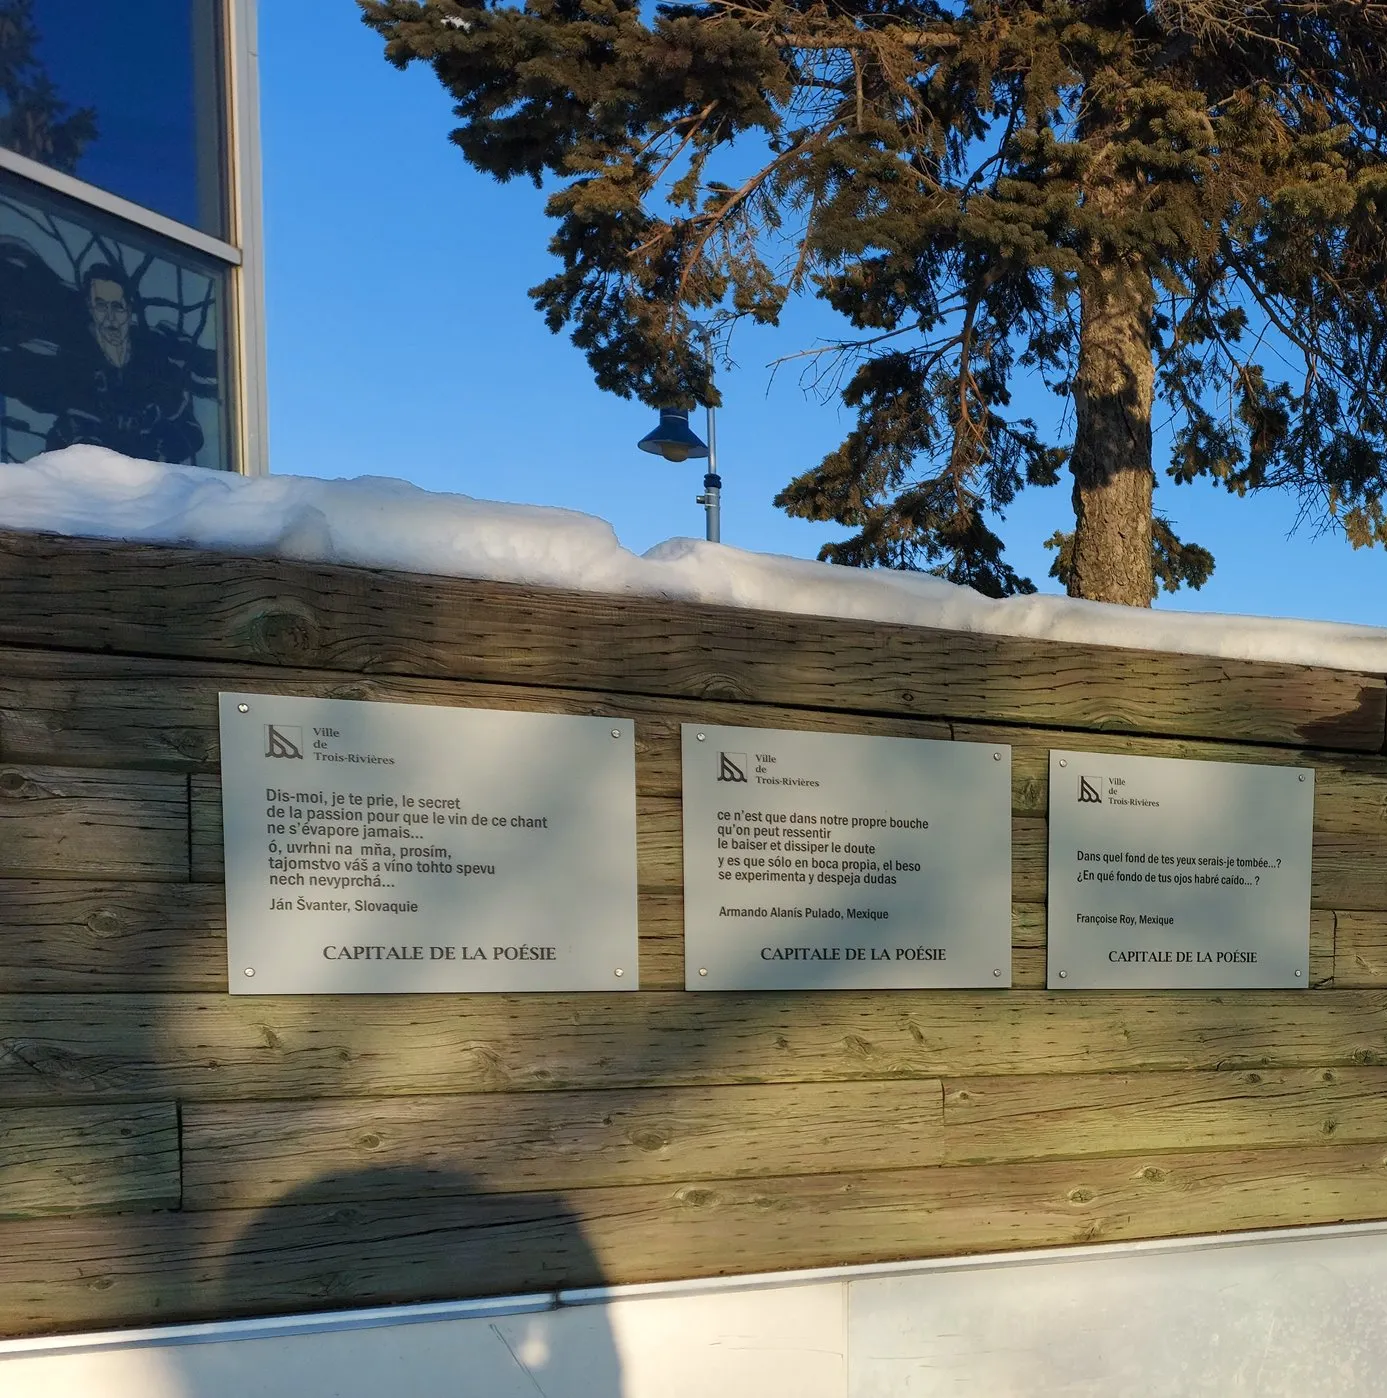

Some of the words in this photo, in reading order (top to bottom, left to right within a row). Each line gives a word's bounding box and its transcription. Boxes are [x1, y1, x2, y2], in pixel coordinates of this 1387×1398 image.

[312, 727, 339, 737] Ville
[313, 739, 327, 749] de
[313, 751, 395, 765] Trois-Rivières
[755, 775, 819, 787] Trois-Rivières
[266, 788, 327, 805] Dis-moi,
[330, 791, 345, 807] je
[348, 793, 362, 805] te
[366, 793, 397, 809] prie,
[402, 794, 414, 807] le
[418, 796, 461, 809] secret
[266, 805, 285, 818] de
[289, 805, 302, 818] la
[306, 806, 362, 823] passion
[367, 811, 400, 825] pour
[402, 813, 428, 826] que
[432, 811, 445, 824] le
[447, 812, 467, 825] vin
[471, 813, 488, 826] de
[491, 816, 506, 826] ce
[510, 815, 547, 828] chant
[717, 811, 730, 820] ce
[765, 813, 786, 825] que
[789, 812, 816, 824] dans
[820, 814, 848, 825] notre
[851, 817, 886, 829] propre
[889, 816, 928, 829] bouche
[267, 823, 285, 834] ne
[361, 824, 423, 841] jamais...
[753, 825, 779, 839] peut
[782, 826, 831, 839] ressentir
[268, 839, 282, 855] ó,
[287, 840, 330, 854] uvrhni
[335, 845, 352, 854] na
[360, 842, 395, 858] mňa,
[400, 843, 451, 860] prosím,
[717, 837, 728, 849] le
[731, 838, 767, 850] baiser
[769, 840, 781, 851] et
[784, 840, 829, 854] dissiper
[831, 841, 841, 853] le
[843, 842, 875, 854] doute
[268, 856, 340, 873] tajomstvo
[344, 857, 368, 871] váš
[372, 861, 380, 871] a
[383, 858, 412, 872] víno
[416, 860, 452, 873] tohto
[456, 864, 495, 876] spevu
[717, 856, 724, 868] y
[727, 856, 740, 866] es
[743, 857, 764, 869] que
[767, 855, 791, 867] sólo
[794, 859, 808, 868] en
[811, 857, 838, 869] boca
[841, 858, 879, 872] propia,
[883, 859, 892, 870] el
[895, 860, 920, 871] beso
[1077, 850, 1100, 861] Dans
[1102, 851, 1122, 864] quel
[1125, 852, 1145, 863] fond
[1147, 853, 1159, 863] de
[1161, 854, 1174, 864] tes
[1176, 856, 1196, 867] yeux
[1197, 855, 1234, 868] serais-je
[1236, 856, 1281, 868] tombée...?
[269, 872, 304, 885] nech
[309, 872, 394, 890] nevyprchá...
[718, 870, 731, 880] se
[734, 869, 805, 884] experimenta
[808, 873, 814, 884] y
[817, 871, 860, 885] despeja
[863, 872, 896, 884] dudas
[1076, 869, 1094, 882] ¿En
[1096, 870, 1114, 883] qué
[1116, 870, 1142, 882] fondo
[1144, 872, 1156, 882] de
[1157, 873, 1171, 882] tus
[1173, 873, 1192, 885] ojos
[1194, 873, 1219, 884] habré
[1254, 875, 1259, 885] ?
[269, 897, 292, 910] Ján
[296, 895, 350, 912] Švanter,
[354, 899, 418, 914] Slovaquie
[718, 906, 767, 917] Armando
[770, 906, 802, 917] Alanís
[805, 907, 843, 918] Pulado,
[846, 908, 888, 920] Mexique
[1076, 913, 1117, 925] Françoise
[1119, 914, 1136, 926] Roy,
[1139, 914, 1173, 926] Mexique
[322, 945, 423, 960] CAPITALE
[429, 946, 455, 960] DE
[462, 947, 487, 960] LA
[493, 943, 556, 960] POÉSIE
[760, 947, 840, 960] CAPITALE
[845, 948, 865, 960] DE
[871, 948, 890, 960] LA
[895, 945, 946, 960] POÉSIE
[1108, 950, 1172, 962] CAPITALE
[1176, 951, 1192, 962] DE
[1196, 951, 1212, 962] LA
[1216, 949, 1257, 962] POÉSIE
